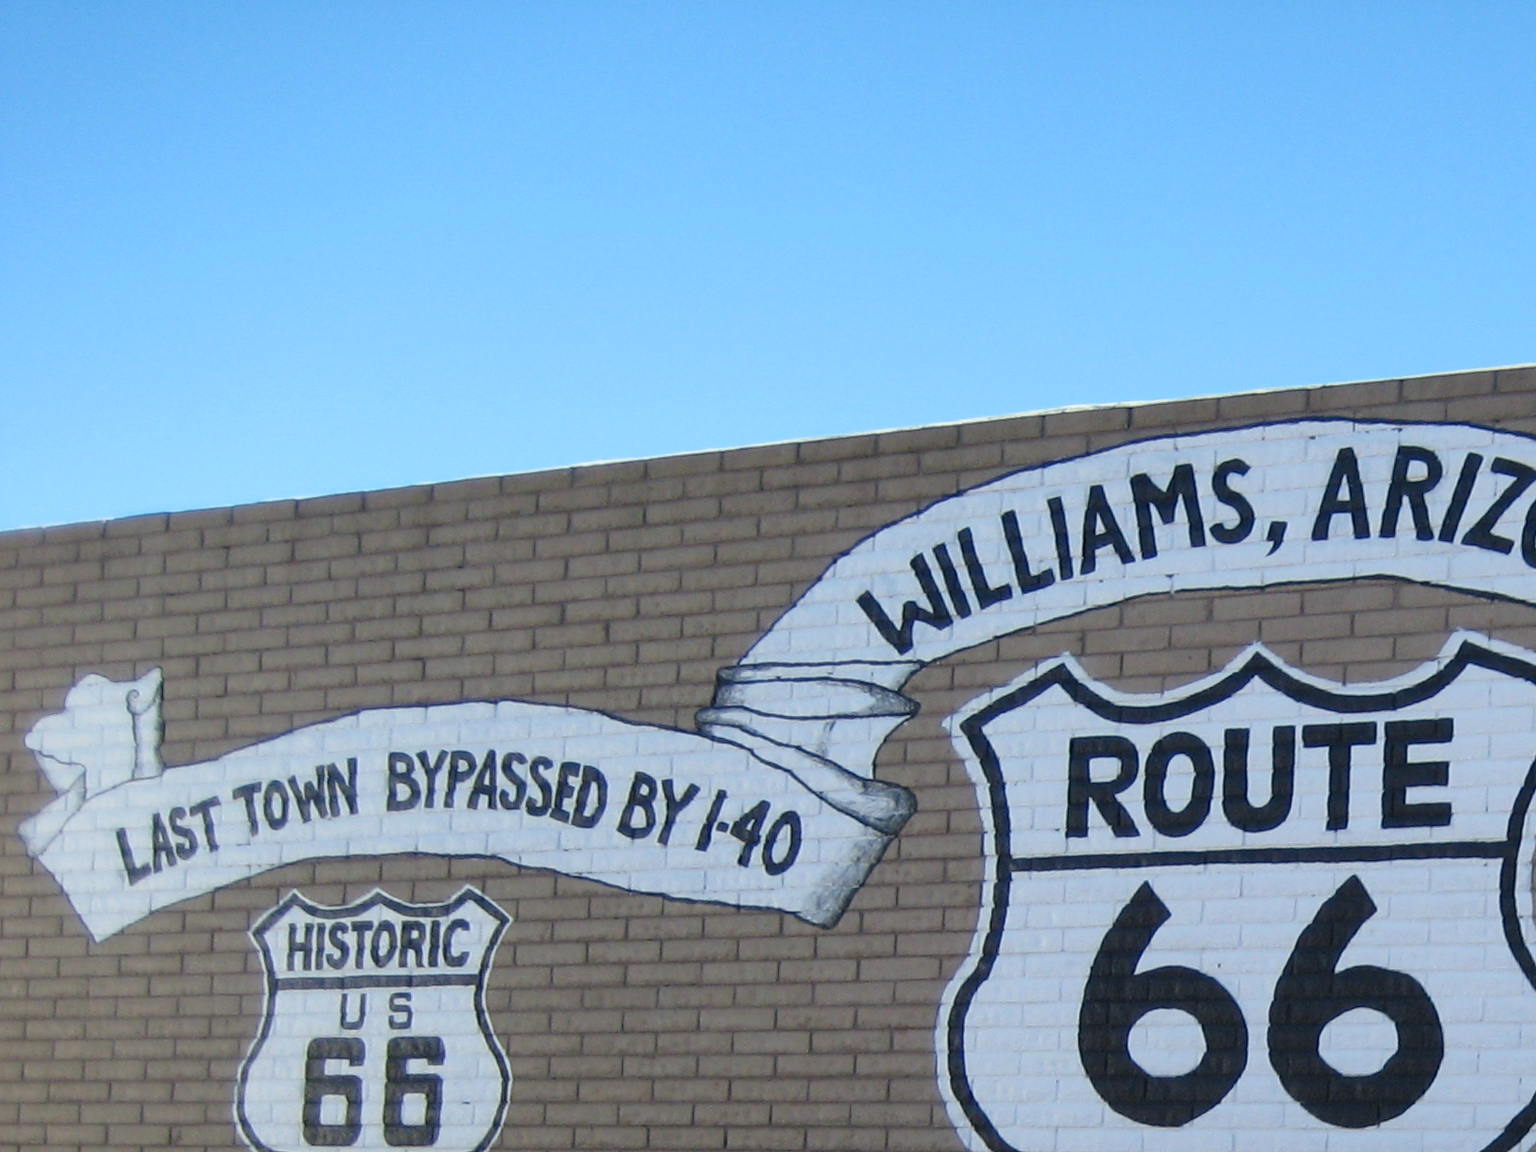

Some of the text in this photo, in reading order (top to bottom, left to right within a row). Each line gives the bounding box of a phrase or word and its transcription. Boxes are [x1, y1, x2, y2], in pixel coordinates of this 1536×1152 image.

[857, 458, 1287, 653] WILLIAMS,
[117, 750, 804, 886] LAST TOWN BYPASSED BY I-40
[1065, 718, 1454, 838] ROUTE
[286, 918, 471, 972] HISTORIC
[1077, 875, 1444, 1129] 66
[302, 1036, 446, 1147] 66
